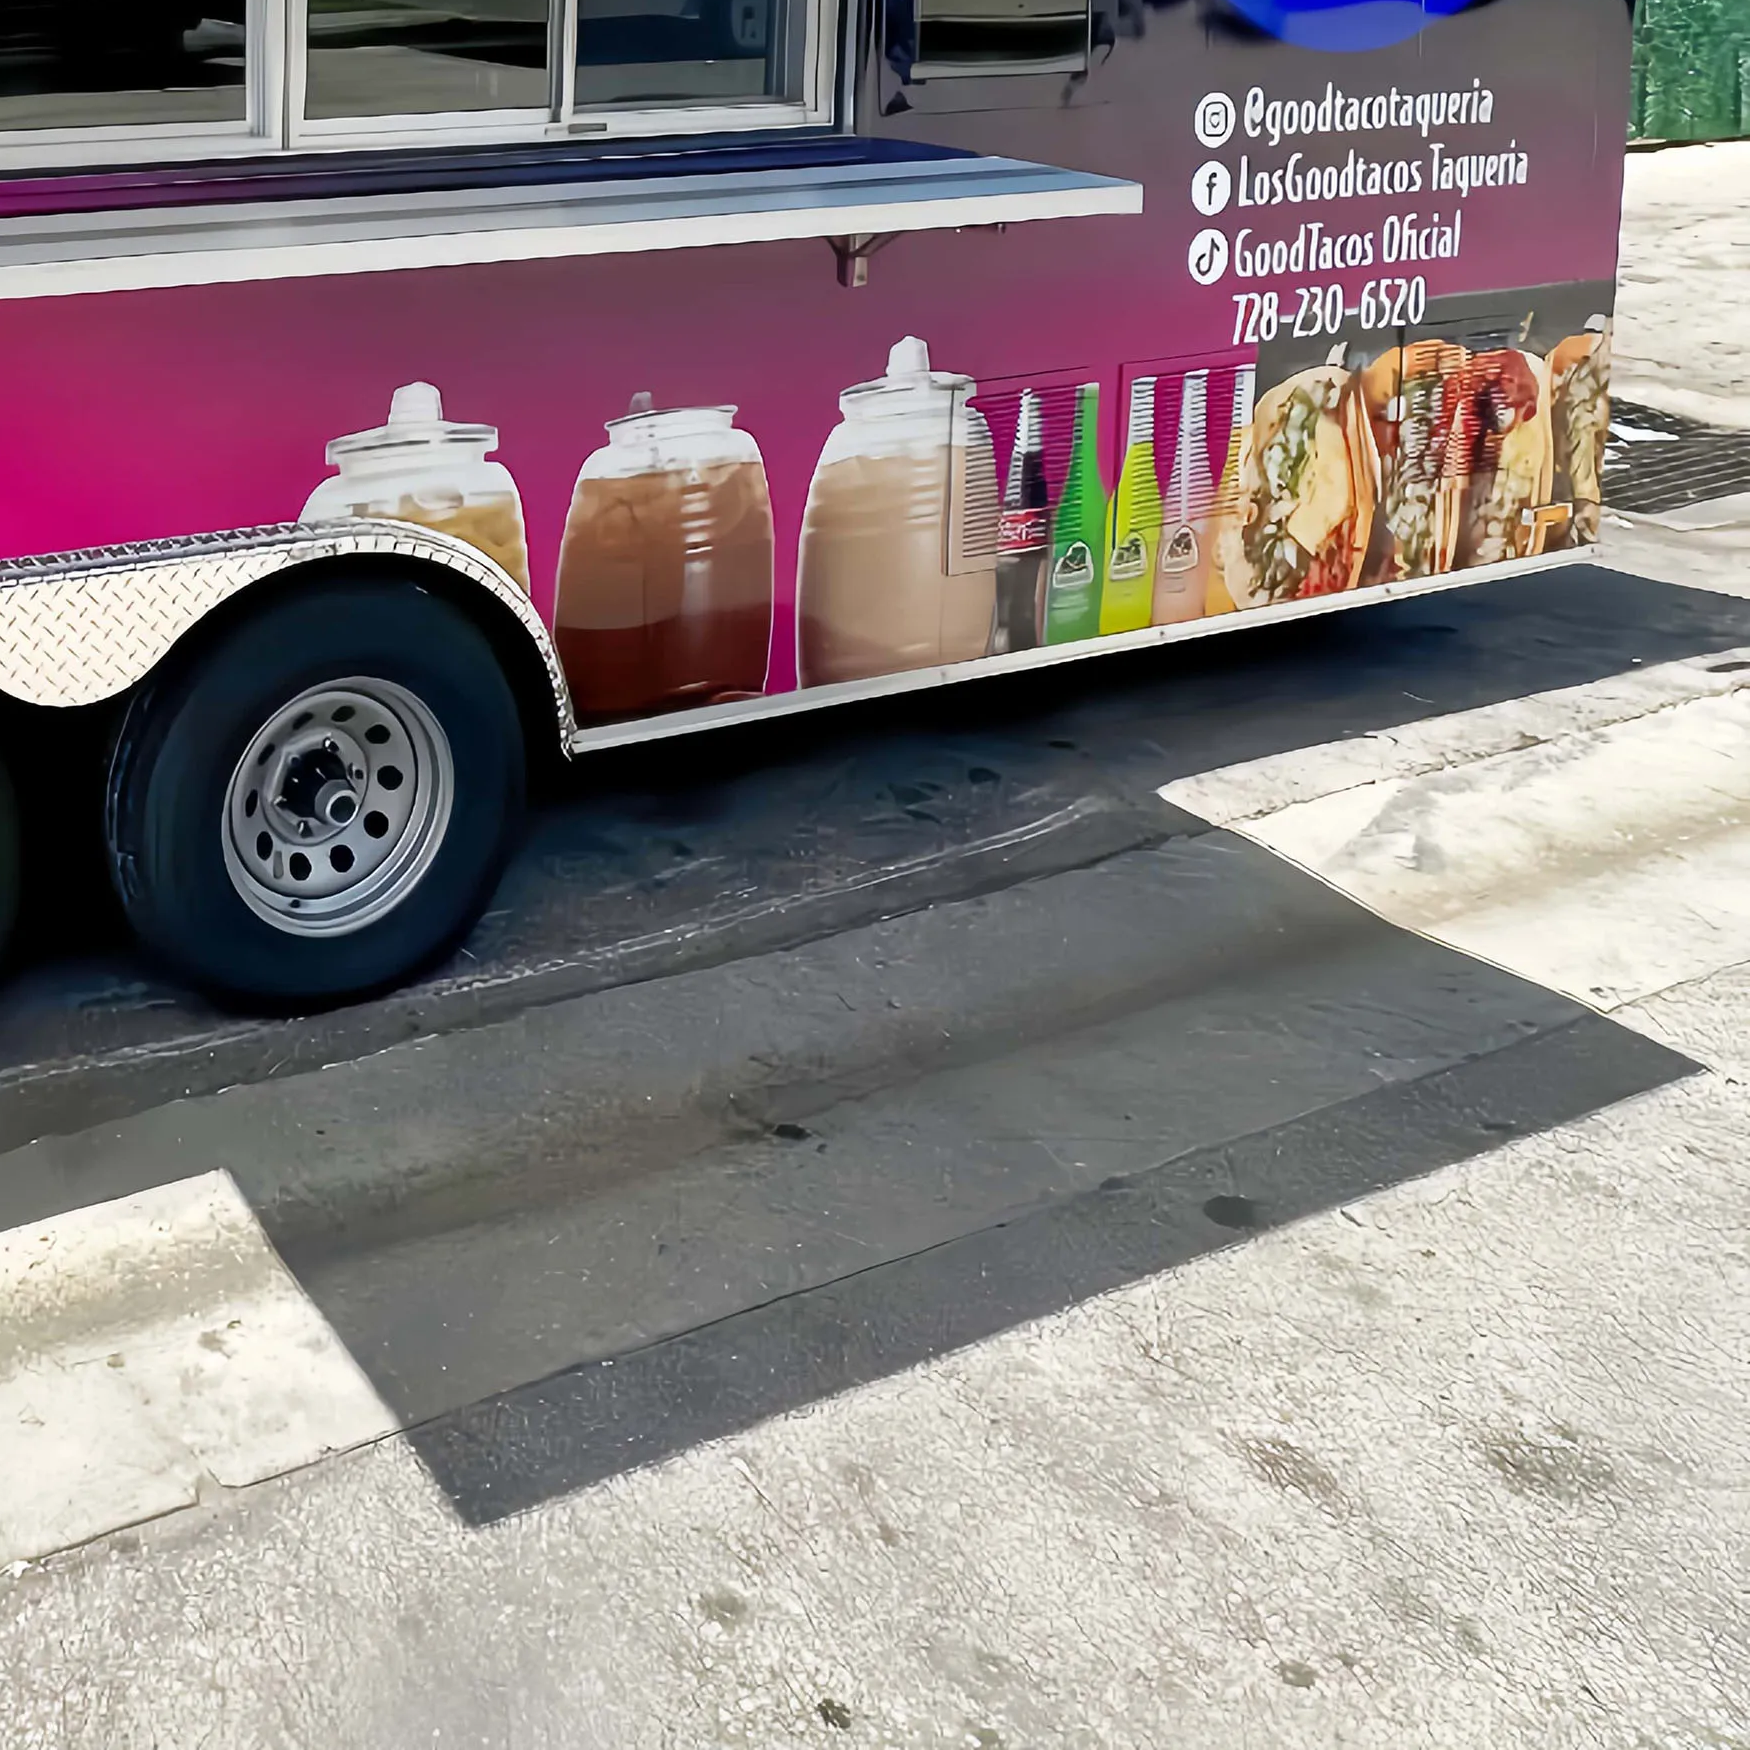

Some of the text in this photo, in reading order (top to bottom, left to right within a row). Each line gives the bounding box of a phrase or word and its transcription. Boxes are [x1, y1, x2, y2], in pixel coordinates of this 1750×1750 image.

[1243, 77, 1494, 147] @goodtacotaqueria
[1237, 138, 1529, 208] LosGoodtacos Taqueria
[1234, 208, 1462, 278] GoodTacos Oficial
[1231, 275, 1427, 346] 728-230-6520
